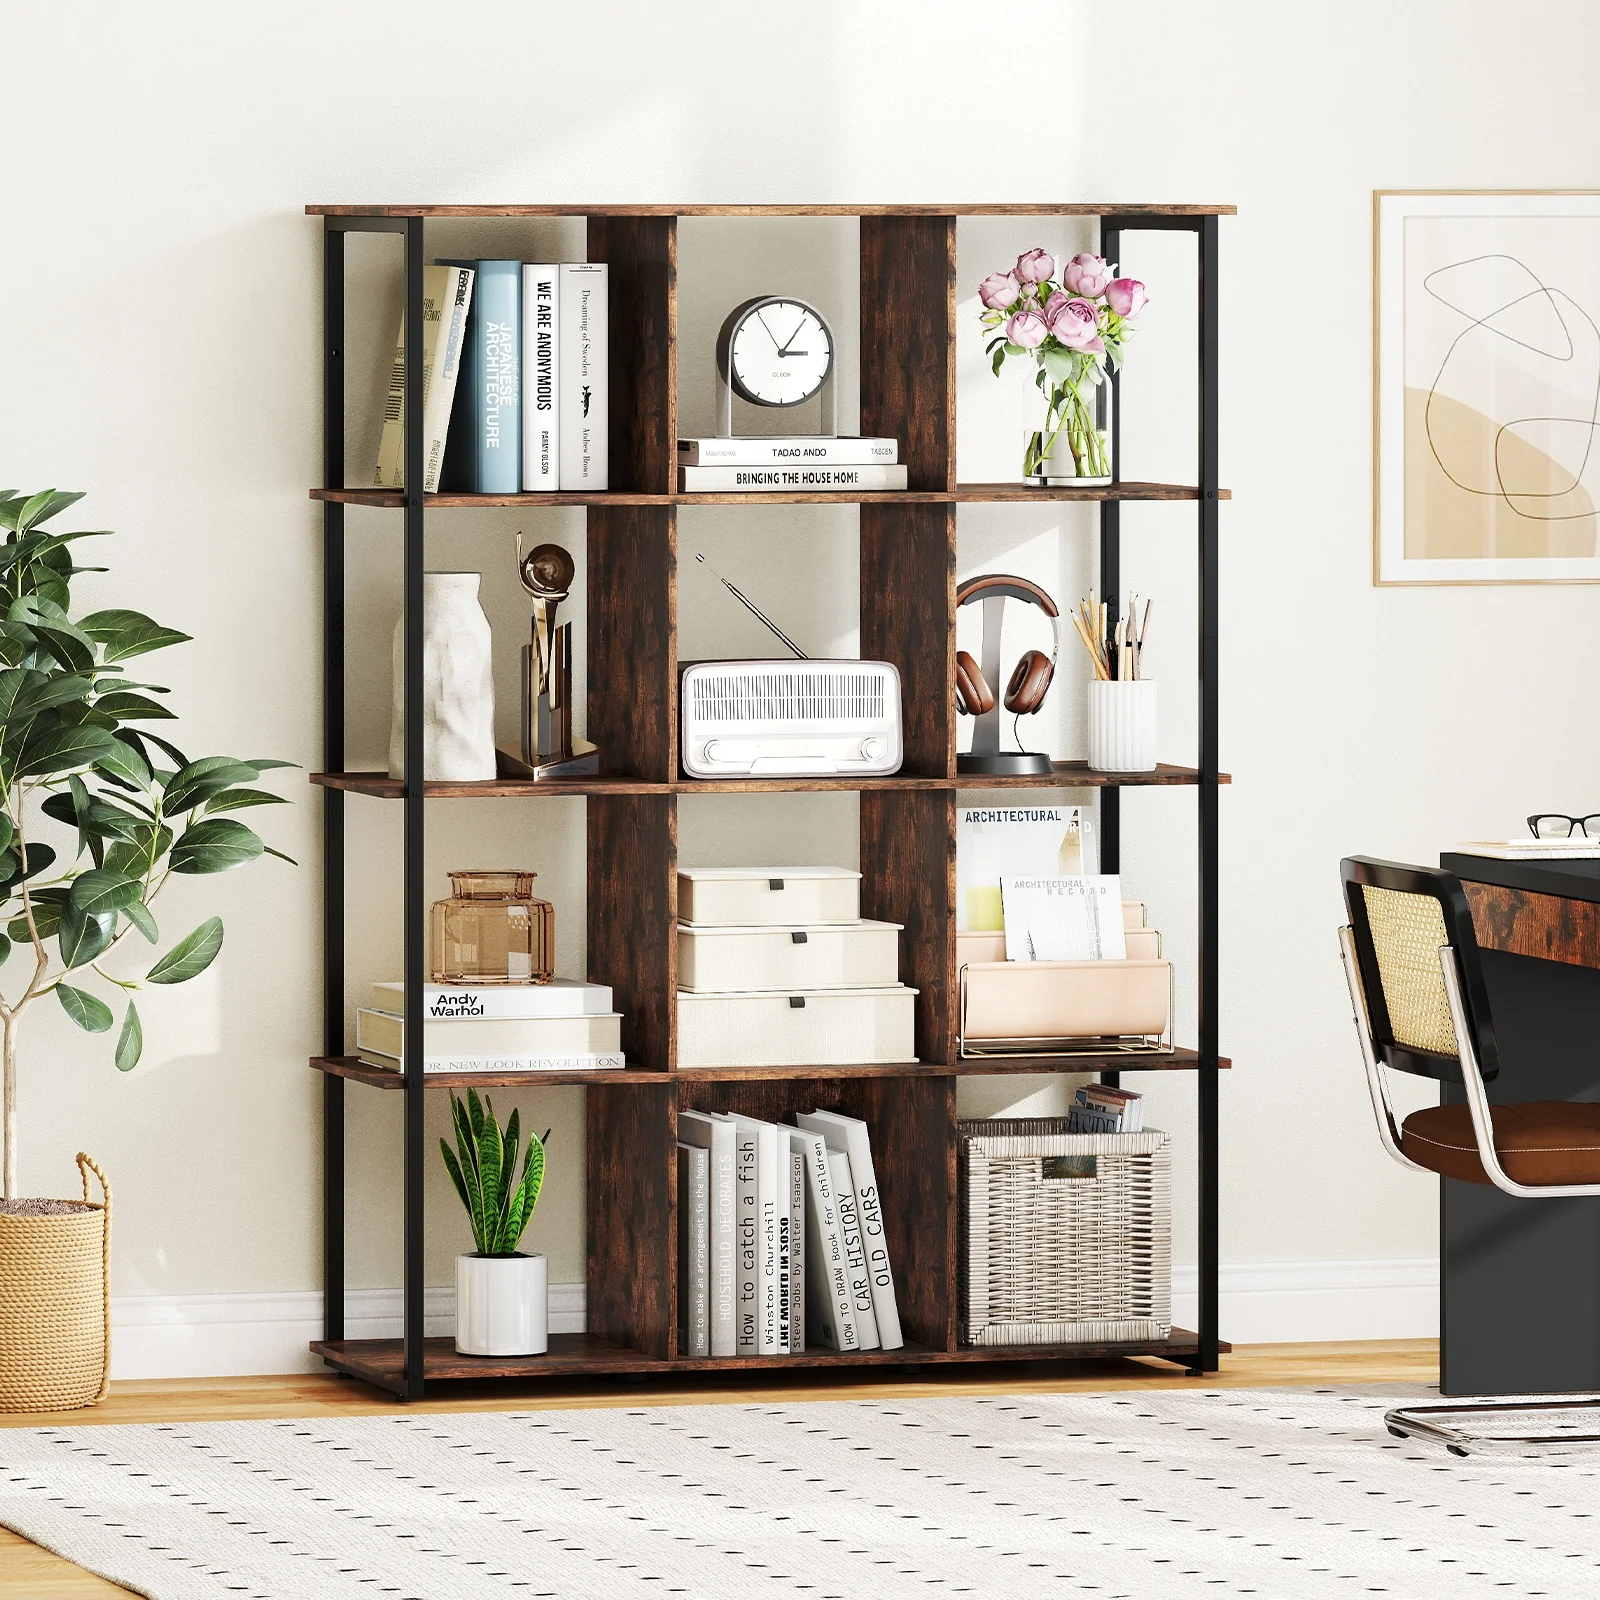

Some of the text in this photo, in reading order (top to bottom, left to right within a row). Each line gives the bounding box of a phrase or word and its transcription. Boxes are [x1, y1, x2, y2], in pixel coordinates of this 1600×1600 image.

[454, 270, 470, 307] FRANK
[537, 282, 551, 410] WE ARE ANONYMOUS
[580, 290, 591, 377] Dreaming of Sweden
[500, 322, 512, 406] JAPANESE
[486, 322, 500, 448] ARCHITECTURE
[541, 454, 549, 475] OLSON
[772, 448, 827, 457] TADAO ANDO
[736, 472, 859, 484] BRINGING THE HOUSE HOME
[965, 811, 1062, 822] ARCHITECTURAL
[1015, 880, 1084, 889] ARCHITECTURAL
[430, 1004, 484, 1017] Warhol
[437, 993, 478, 1007] Andy
[449, 1061, 481, 1070] NEW
[485, 1060, 524, 1069] LOOK
[529, 1058, 620, 1068] REVOLUTION
[696, 1153, 704, 1178] house
[696, 1183, 704, 1198] the
[696, 1203, 704, 1213] in
[697, 1219, 705, 1273] arrangement
[720, 1154, 731, 1320] HOUSEHOLD DECORATES
[738, 1142, 754, 1345] How to catch a fish
[814, 1142, 855, 1345] HOW TO DRAW Book for children
[860, 1186, 890, 1287] OLD CARS
[793, 1156, 802, 1348] Steve Jobs by Walter Isaacson
[837, 1193, 871, 1311] CAR HISTORY
[697, 1278, 704, 1288] an
[764, 1201, 774, 1345] Winston Churchill
[696, 1293, 704, 1314] make
[697, 1318, 704, 1328] to
